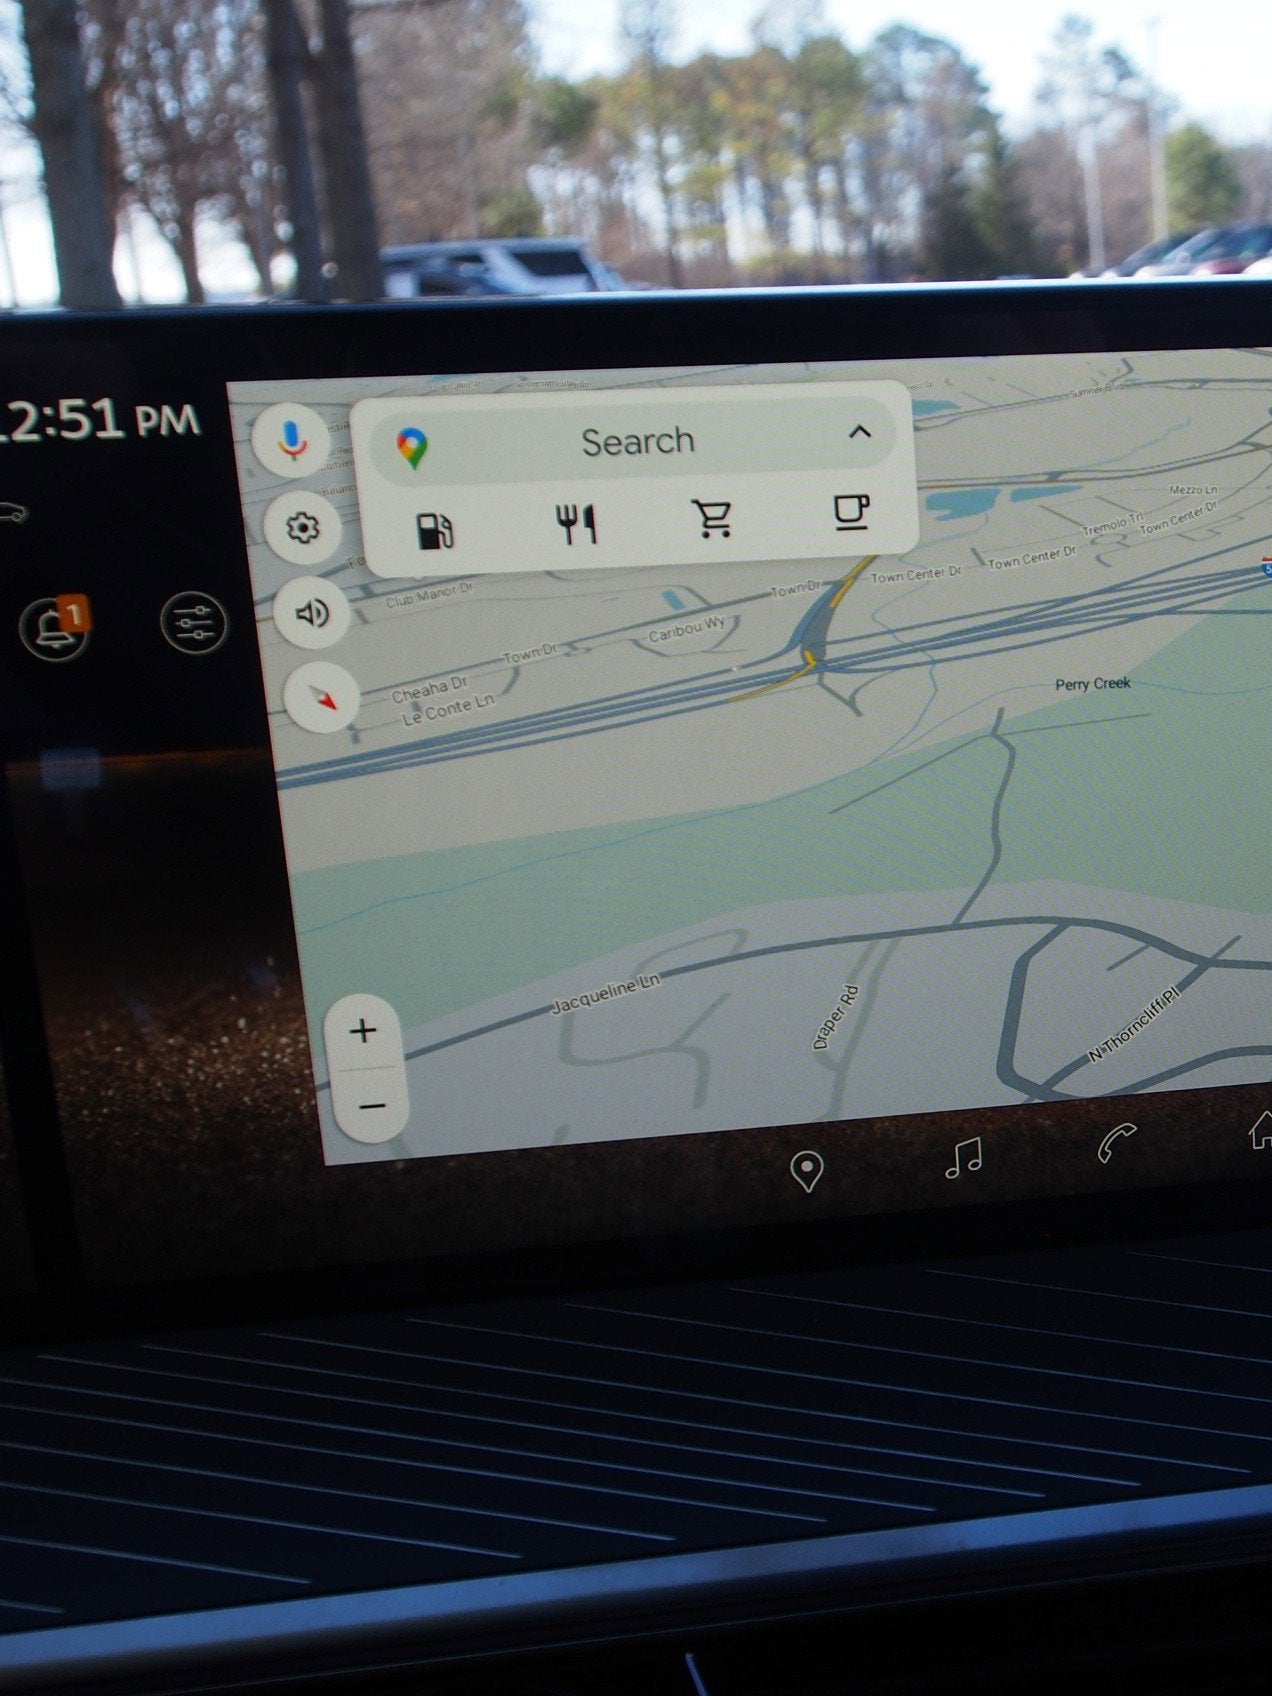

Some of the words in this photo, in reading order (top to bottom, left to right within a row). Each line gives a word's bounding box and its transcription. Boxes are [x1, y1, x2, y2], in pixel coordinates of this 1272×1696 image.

[0, 397, 126, 442] 2:51
[135, 404, 201, 438] PM
[581, 425, 696, 456] Search
[1170, 485, 1202, 494] Mezzo
[1083, 518, 1127, 536] Tremolo
[1141, 519, 1169, 535] Town
[1170, 508, 1204, 525] Center
[1206, 501, 1218, 512] Dr
[989, 556, 1020, 570] Town
[1022, 550, 1061, 565] Center
[1063, 545, 1076, 555] Dr
[770, 584, 803, 598] Town
[805, 579, 822, 591] Dr
[871, 572, 905, 583] Town
[906, 568, 946, 581] Center
[949, 566, 962, 575] Dr
[386, 594, 415, 609] Club
[459, 582, 475, 594] Dr
[67, 604, 82, 626] 1
[649, 622, 703, 644] Caribou
[703, 615, 726, 633] Wy
[502, 648, 543, 664] Town
[543, 642, 559, 656] Dr
[391, 679, 449, 704] Cheaha
[450, 673, 469, 690] Dr
[1056, 679, 1090, 693] Perry
[1093, 676, 1132, 690] Creek
[402, 713, 422, 727] Le
[424, 700, 473, 721] Conte
[473, 692, 496, 708] Ln
[551, 981, 638, 1015] Jacqueline
[639, 973, 661, 988] Ln
[813, 1004, 846, 1050] Draper
[839, 984, 859, 1006] Rd
[1088, 1047, 1103, 1063] N
[1102, 998, 1164, 1052] Thorncliff
